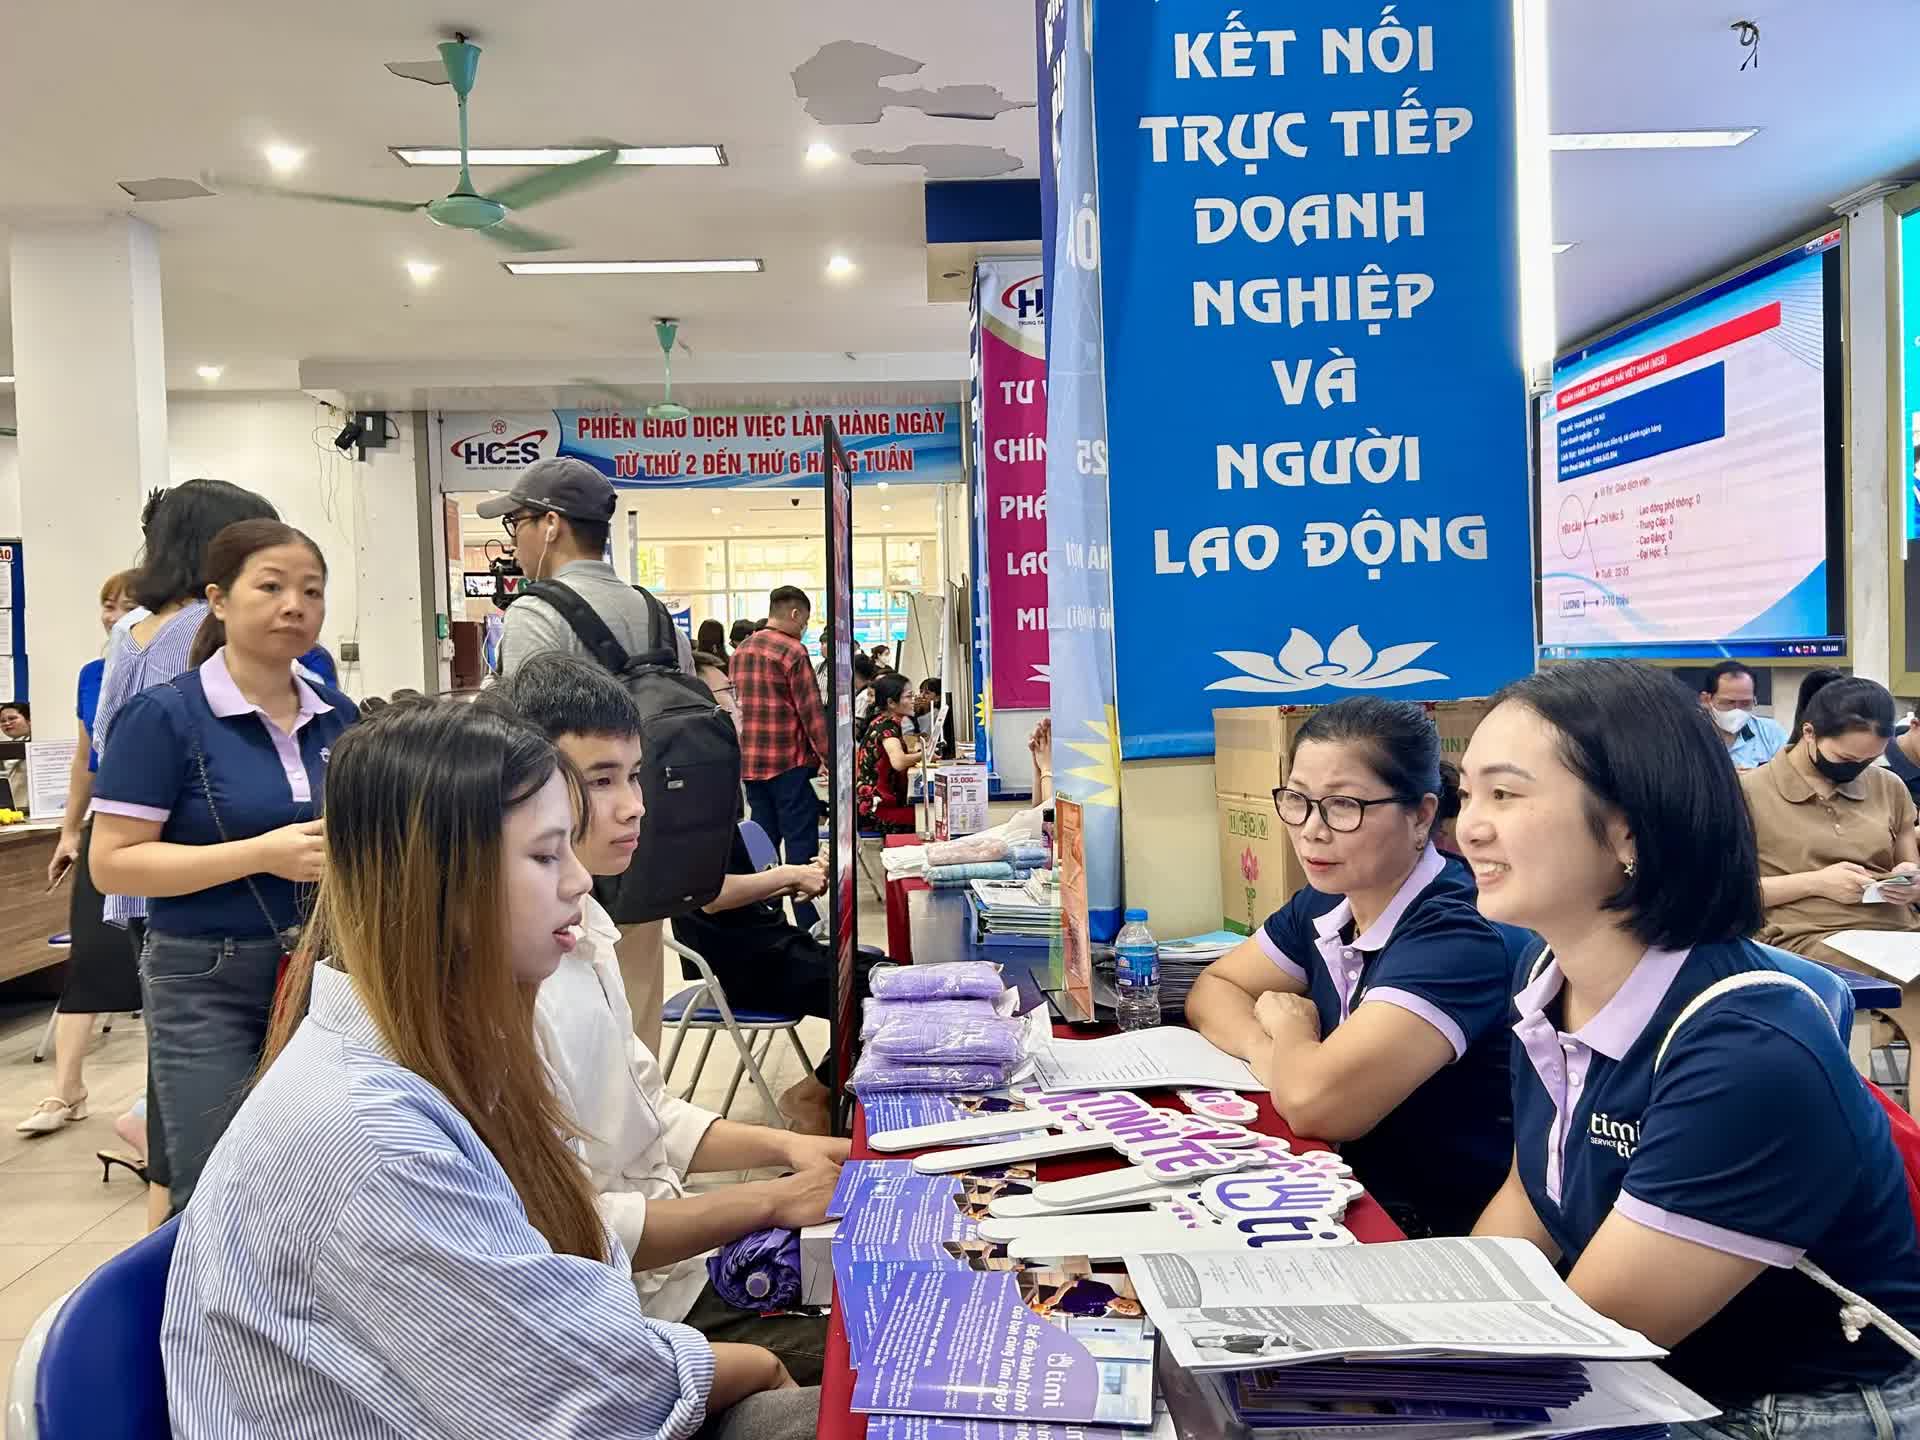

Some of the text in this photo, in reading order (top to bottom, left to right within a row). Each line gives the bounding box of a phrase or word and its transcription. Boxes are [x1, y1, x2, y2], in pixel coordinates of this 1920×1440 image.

[1174, 5, 1434, 79] KẾT NỐI
[1138, 87, 1473, 176] TRỰC TIẾP
[1193, 191, 1426, 247] DOANH
[1192, 263, 1435, 336] NGHIỆP
[999, 379, 1035, 405] TƯ
[1271, 346, 1357, 410] VÀ
[577, 413, 637, 440] PHIÊN
[693, 415, 738, 442] DỊCH
[744, 412, 786, 442] VIỆC
[839, 409, 890, 435] HÀNG
[896, 407, 945, 434] NGÀY
[465, 442, 540, 465] HCES
[614, 450, 640, 478] TỪ
[643, 449, 682, 476] THỨ
[685, 455, 697, 475] 2
[703, 446, 742, 475] ĐẾN
[748, 449, 785, 474] THỨ
[789, 455, 801, 474] 6
[864, 442, 914, 472] TUẦN
[993, 432, 1048, 465] CHÍN
[1216, 427, 1421, 490] NGƯỜI
[999, 490, 1048, 521] PHÁ
[1154, 508, 1488, 580] LAO ĐỘNG
[1017, 607, 1049, 631] MI
[1077, 1094, 1181, 1144] TINH
[1591, 1112, 1641, 1142] timi
[1590, 1136, 1617, 1148] SERVICE
[1006, 1321, 1022, 1335] bạn
[1000, 1336, 1020, 1357] cùng
[999, 1358, 1016, 1380] Timi
[1018, 1356, 1036, 1381] hành
[1013, 1381, 1032, 1412] trình
[1042, 1371, 1067, 1409] timi
